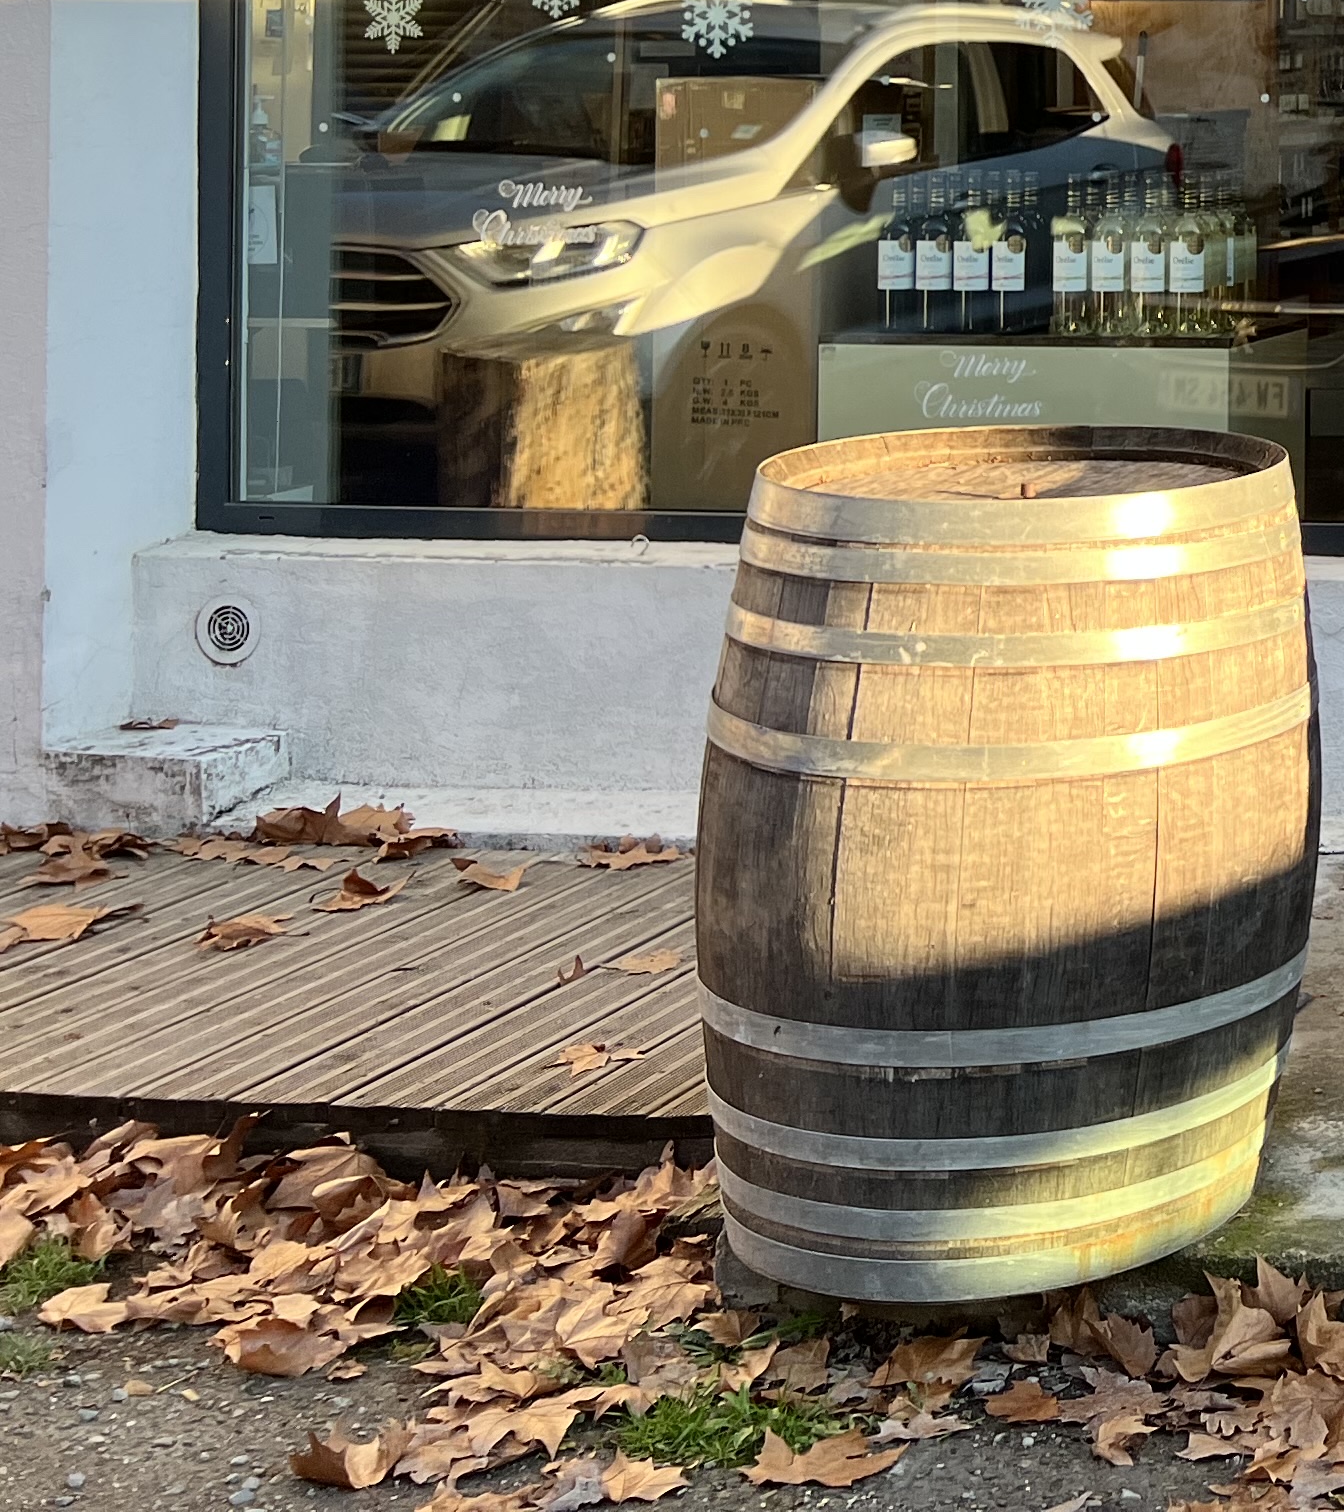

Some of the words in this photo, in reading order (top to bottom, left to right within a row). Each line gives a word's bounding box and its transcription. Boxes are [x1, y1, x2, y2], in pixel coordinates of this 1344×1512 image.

[498, 179, 592, 212] Merry
[940, 349, 1037, 381] Merry
[914, 381, 1043, 420] Christmas
